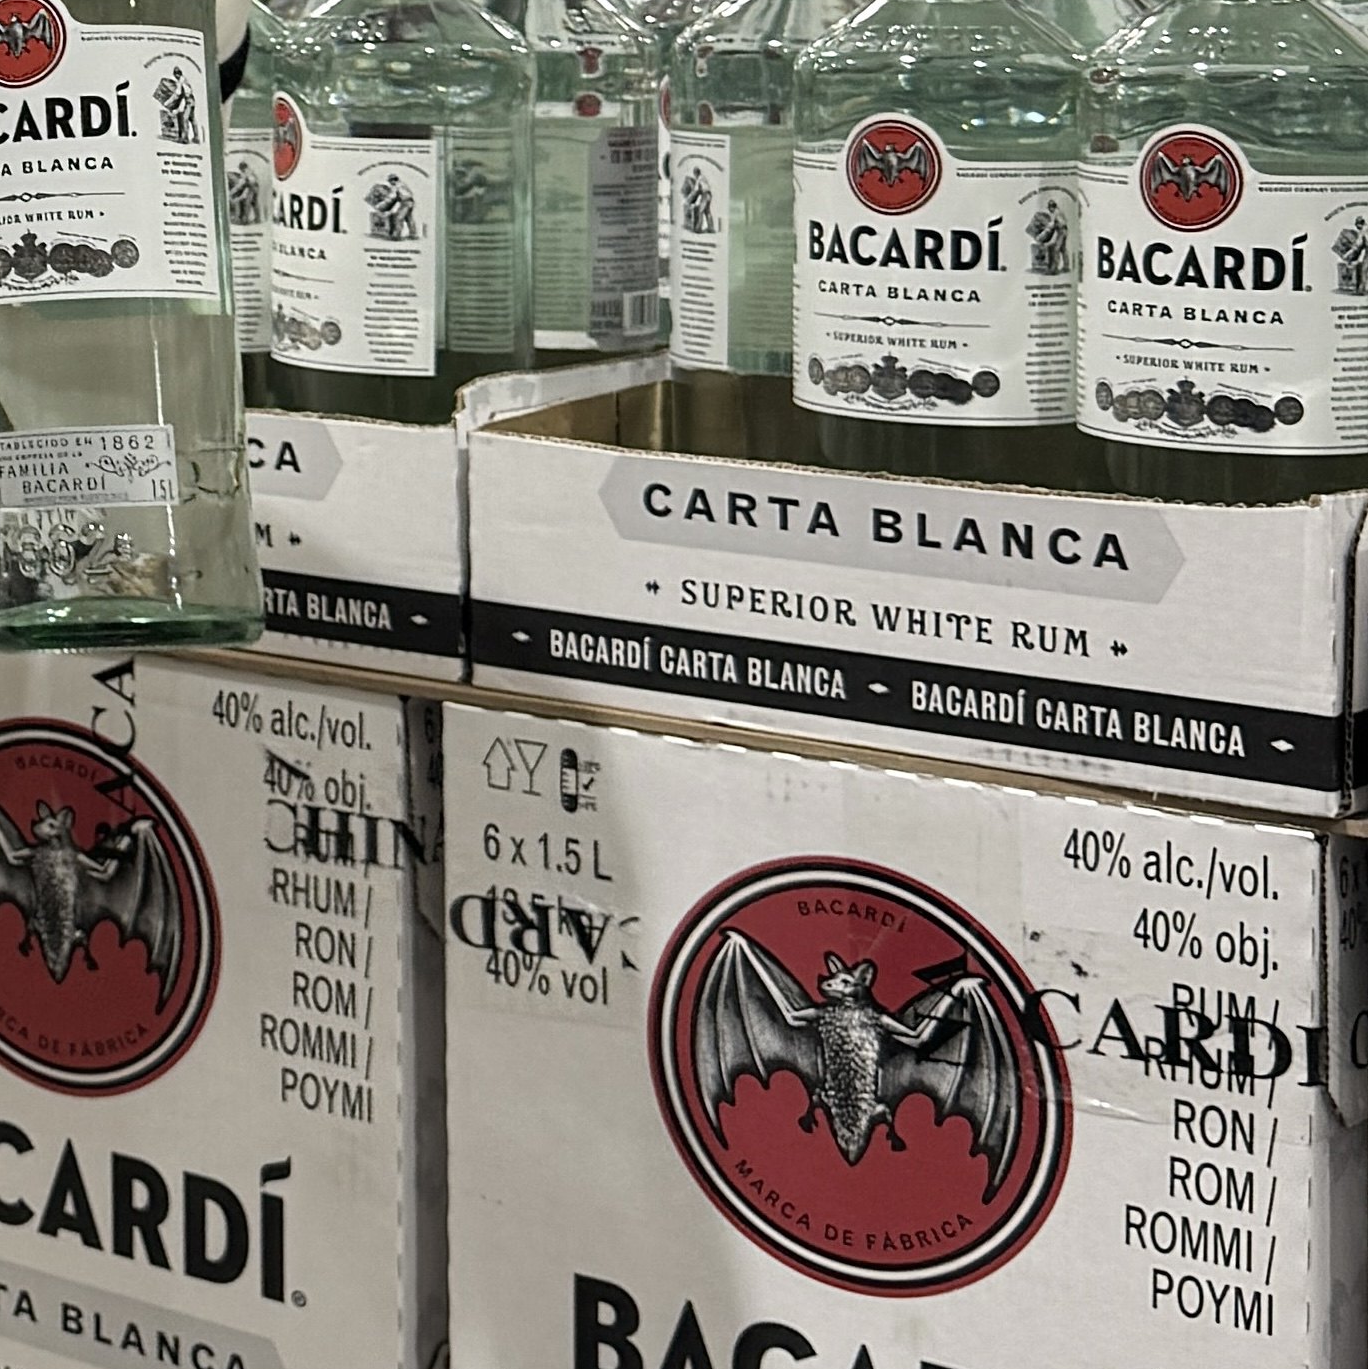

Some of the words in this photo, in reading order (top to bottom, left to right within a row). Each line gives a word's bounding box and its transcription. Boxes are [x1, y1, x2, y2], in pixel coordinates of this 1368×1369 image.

[22, 156, 114, 175] BLANCA
[25, 210, 63, 223] WHITE
[68, 209, 94, 220] RUM
[808, 215, 1007, 272] BACARDÍ
[1097, 233, 1312, 293] BACARDÍ
[818, 279, 878, 300] CARTA
[887, 286, 982, 304] BLANCA
[1107, 300, 1173, 322] CARTA
[1183, 306, 1285, 327] BLANCA
[832, 330, 883, 347] SUPERIOR
[887, 333, 928, 349] WHITE
[931, 335, 959, 351] RUM
[1122, 354, 1180, 372] SUPERIOR
[1183, 358, 1227, 373] WHITE
[1231, 360, 1260, 374] RUM
[0, 462, 69, 479] FAMILIA
[101, 435, 154, 451] 1862
[22, 473, 106, 495] BACARDÍ
[642, 481, 840, 538] CARTA
[871, 506, 1131, 572] BLANCA
[307, 591, 391, 631] BLANCA
[680, 579, 857, 628] SUPERIOR
[871, 601, 994, 645] WHITE
[1011, 619, 1091, 658] RUM
[212, 689, 262, 734] 40%
[270, 699, 372, 751] alc./vol.
[549, 628, 652, 672] BACARDÍ
[660, 645, 742, 686] CARTA
[747, 657, 847, 702] BLANCA
[911, 678, 1026, 727] BACARDÍ
[1035, 697, 1124, 741] CARTA
[1133, 714, 1246, 759] BLANCA
[324, 772, 372, 812] obj.
[484, 823, 500, 861] 6
[510, 836, 527, 866] x
[539, 832, 581, 875] 1.5
[594, 840, 612, 881] L
[1063, 828, 1130, 878] 40%
[1144, 839, 1279, 901] alc./vol.
[271, 867, 357, 919] RHUM
[295, 922, 357, 968] RON
[1133, 907, 1203, 959] 40%
[1216, 917, 1279, 979] obj.
[292, 971, 357, 1019] ROM
[561, 967, 607, 1005] vol
[261, 1013, 357, 1069] ROMMI
[281, 1067, 372, 1124] POYMI
[1173, 1099, 1255, 1155] RON
[735, 1157, 812, 1231] MARCA
[824, 1223, 854, 1246] DE
[1169, 1156, 1255, 1215] ROM
[1125, 1203, 1253, 1274] ROMMI
[1151, 1268, 1274, 1336] POYMI
